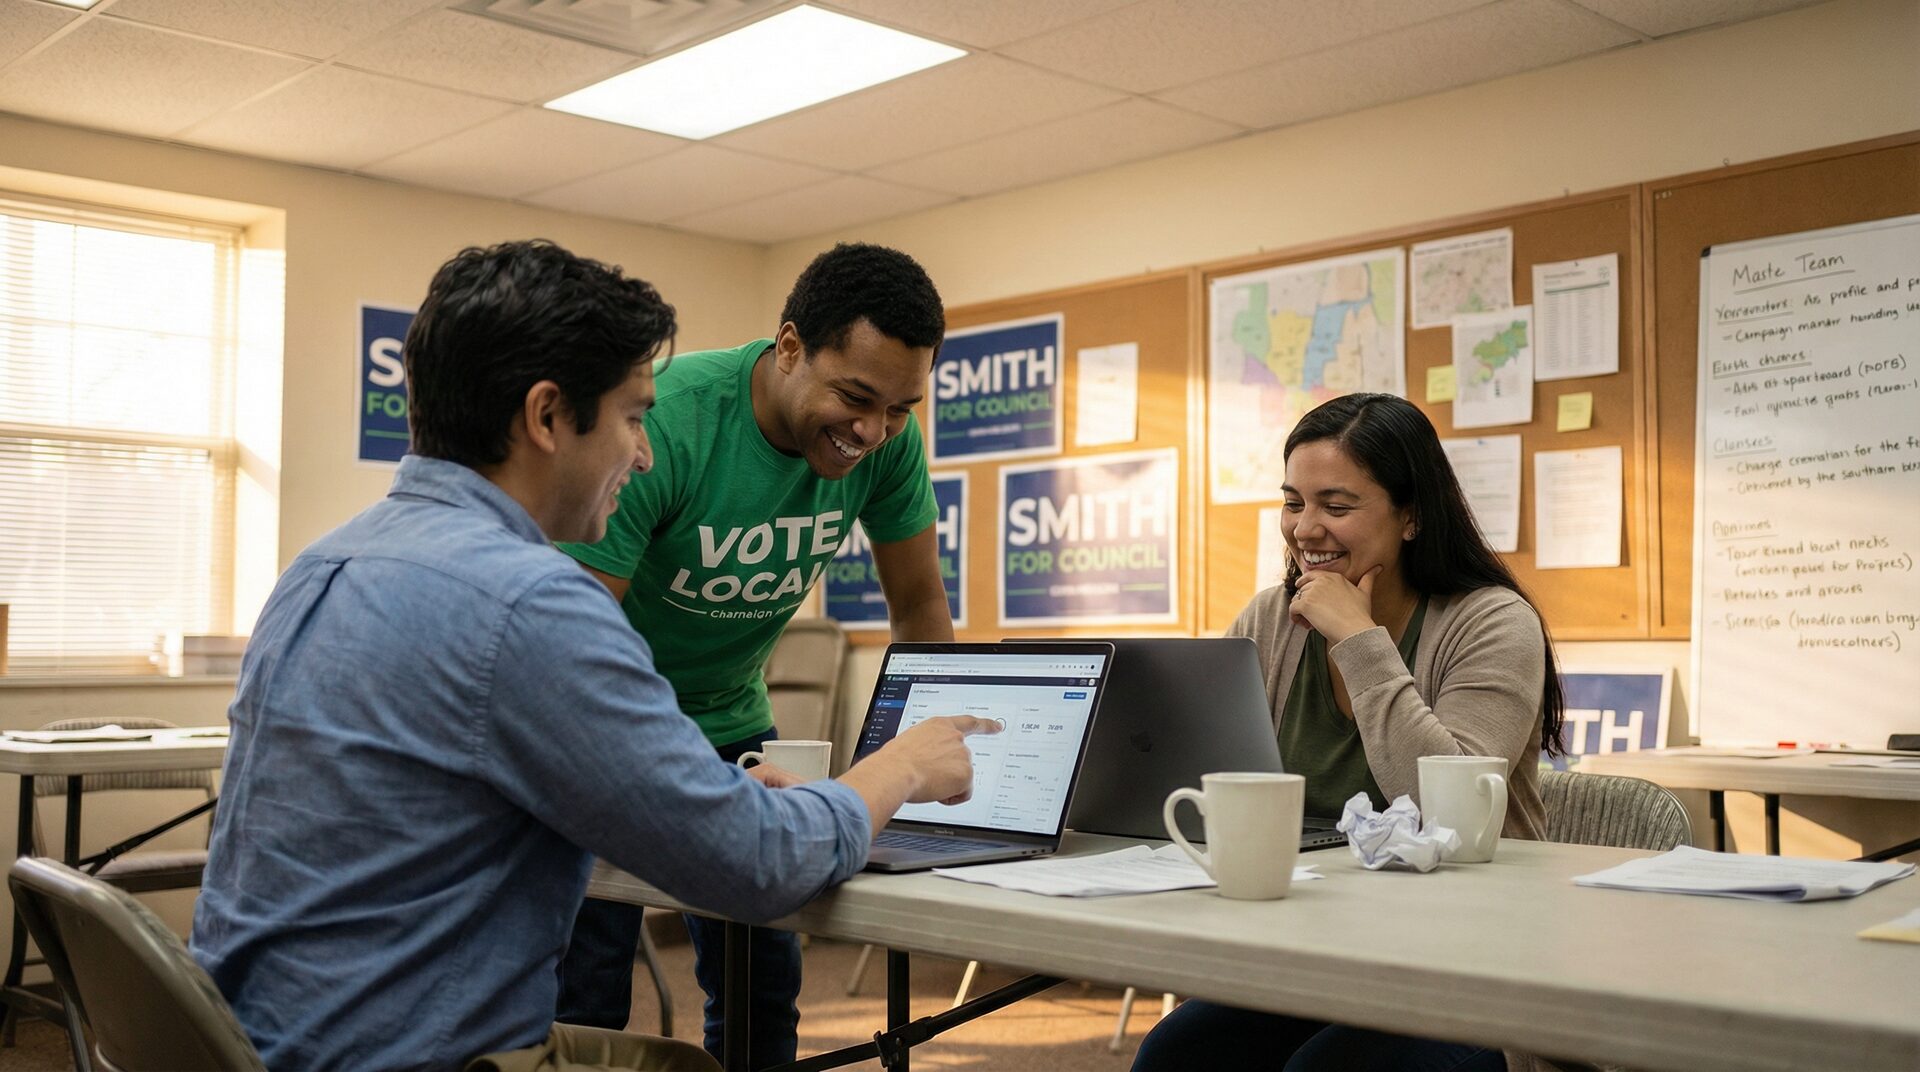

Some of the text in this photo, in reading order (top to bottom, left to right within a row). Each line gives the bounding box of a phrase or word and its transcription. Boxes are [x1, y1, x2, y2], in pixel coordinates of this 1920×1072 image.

[1795, 252, 1845, 273] Team
[1830, 285, 1868, 306] profile
[1877, 277, 1899, 292] and
[938, 345, 1055, 399] SMITH
[366, 392, 409, 418] FO
[938, 391, 1054, 421] FOR COUNCIL
[1854, 443, 1872, 457] for
[1880, 439, 1900, 453] the
[1798, 476, 1811, 489] by
[1817, 472, 1836, 483] the
[1008, 486, 1168, 546] SMITH
[698, 510, 843, 568] VOTE
[828, 562, 866, 583] FOR
[1007, 543, 1167, 576] FOR COUNCIL
[1832, 559, 1849, 571] for
